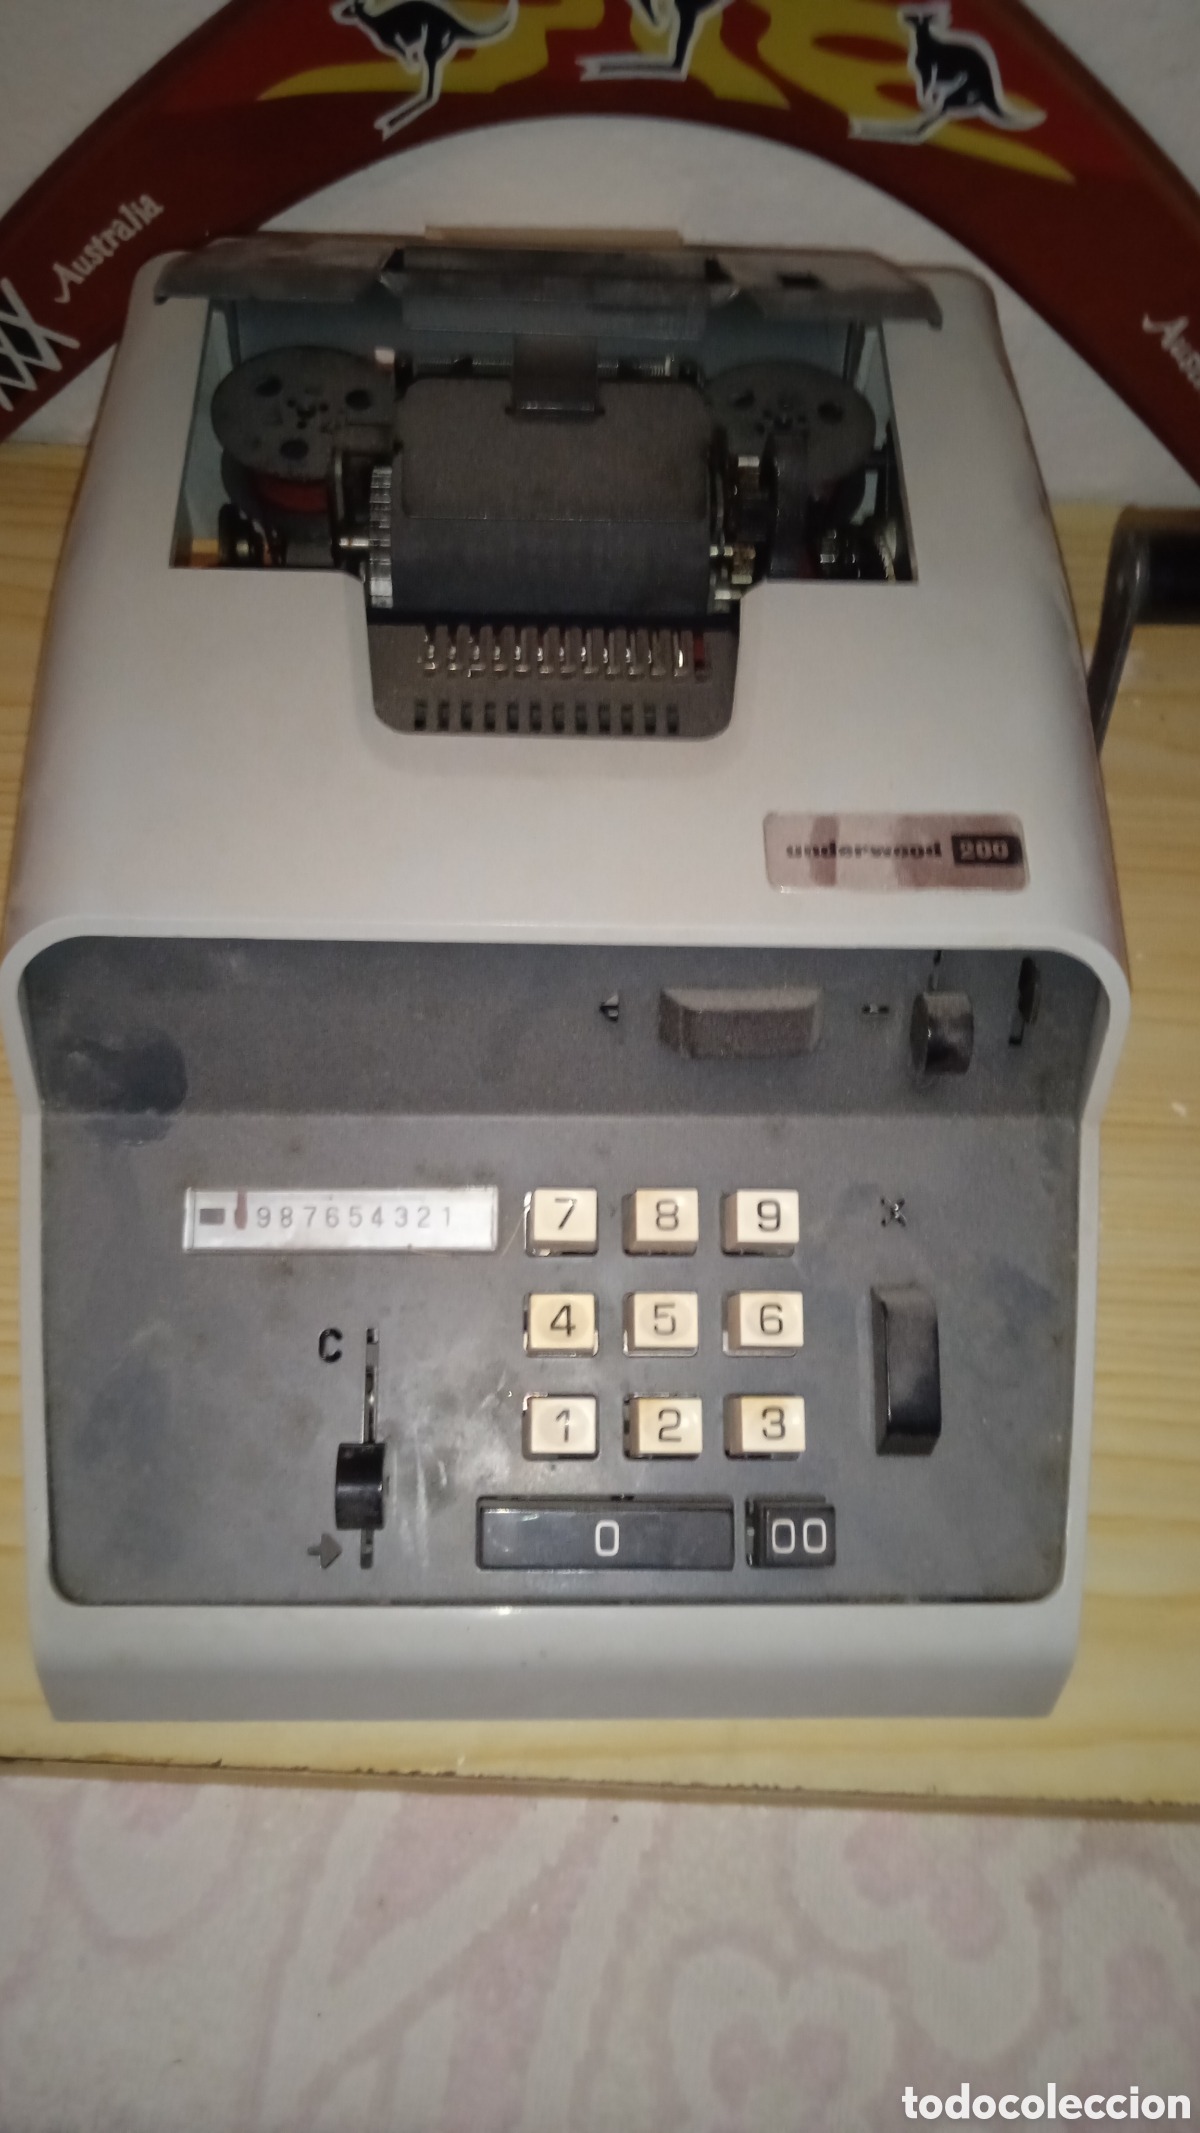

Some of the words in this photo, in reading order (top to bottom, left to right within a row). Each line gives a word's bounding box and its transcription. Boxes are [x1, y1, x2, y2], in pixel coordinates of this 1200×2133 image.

[53, 194, 164, 304] Australia
[959, 838, 1009, 861] 200
[554, 1197, 577, 1230] 7
[656, 1199, 679, 1231] 8
[756, 1199, 781, 1232] 9
[550, 1302, 577, 1338] 4
[653, 1302, 676, 1336] 5
[759, 1302, 783, 1335] 6
[318, 1328, 343, 1363] C
[555, 1408, 571, 1443] 1
[658, 1408, 682, 1443] 2
[761, 1405, 786, 1440] 3
[595, 1519, 620, 1557] 0
[771, 1518, 827, 1554] 00
